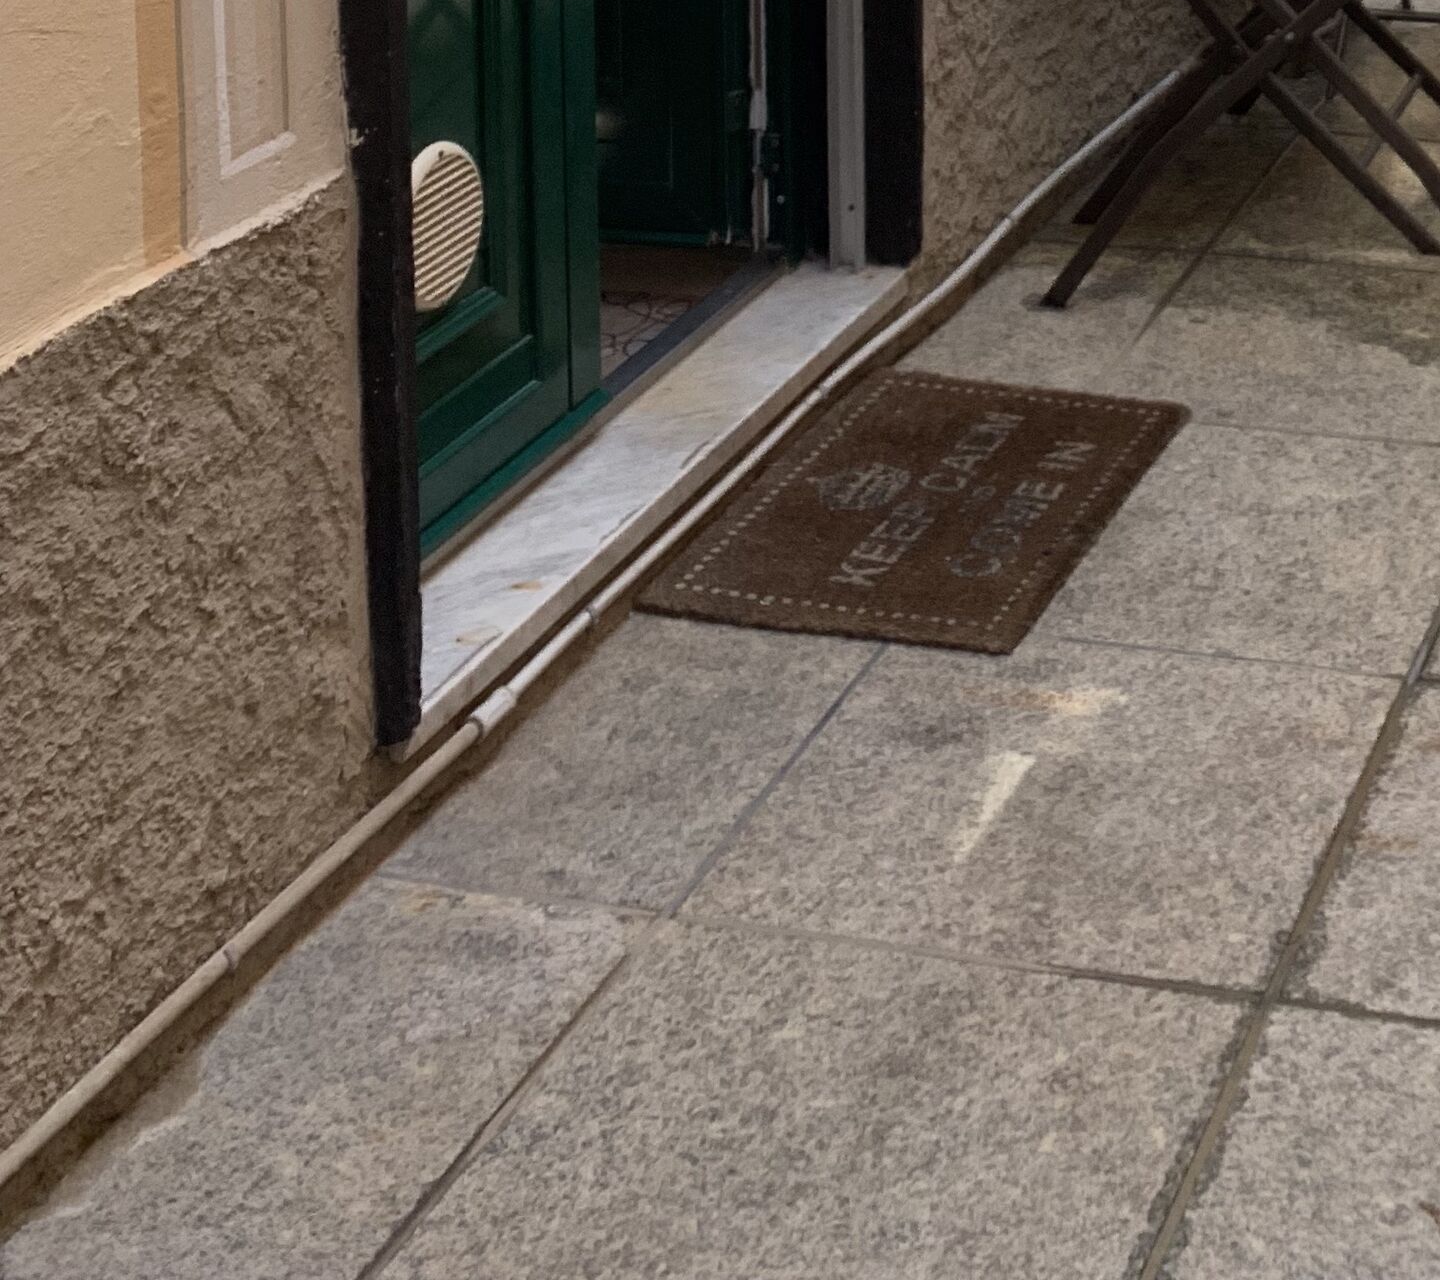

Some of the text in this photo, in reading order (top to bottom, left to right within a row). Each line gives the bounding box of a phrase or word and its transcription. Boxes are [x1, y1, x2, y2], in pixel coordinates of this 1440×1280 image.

[828, 411, 1026, 587] KEEP CALM
[944, 440, 1097, 577] COME IN
